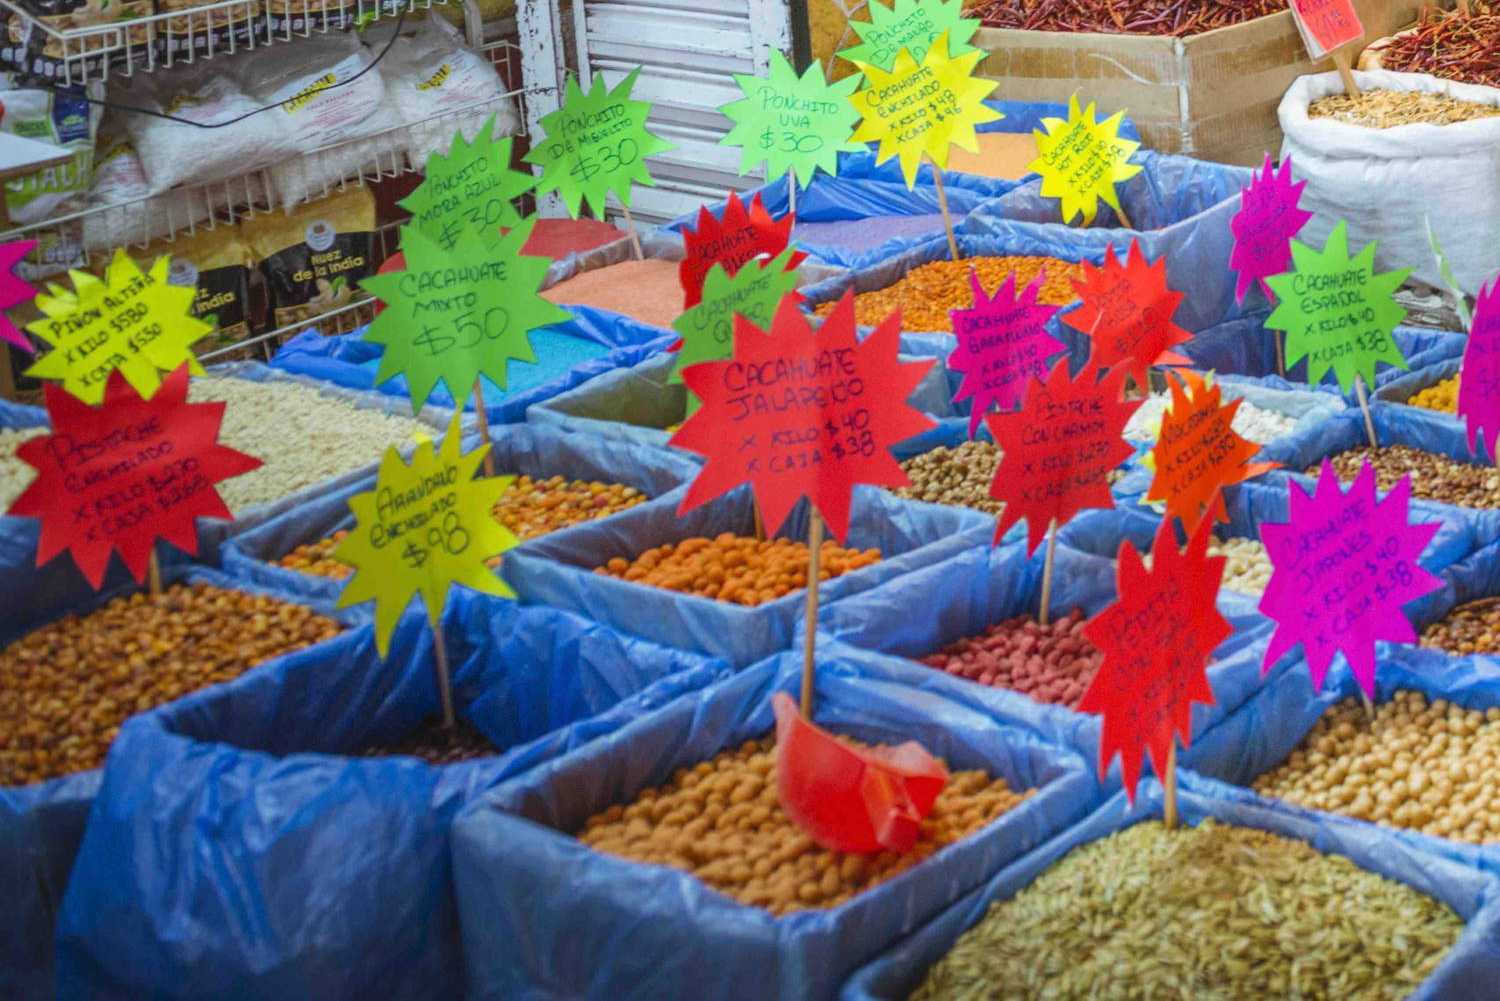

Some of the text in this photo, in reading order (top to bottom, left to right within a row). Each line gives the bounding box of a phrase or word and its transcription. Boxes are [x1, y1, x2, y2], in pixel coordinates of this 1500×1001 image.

[865, 7, 926, 47] PONCHITO
[757, 85, 840, 117] PONCHITO
[866, 65, 935, 108] CACAHUATE
[558, 102, 626, 139] PONCHITO
[779, 111, 811, 129] UVA
[550, 140, 574, 161] DE
[568, 137, 640, 184] $30
[759, 130, 824, 155] $30
[428, 156, 489, 194] PONCHITO
[418, 174, 502, 230] MORA AZUL
[293, 255, 364, 283] de la India
[311, 251, 341, 267] Nuez
[399, 261, 507, 297] CACAHUATE
[1292, 267, 1368, 295] CACAHUATE
[50, 272, 156, 339] PIÑON ALTEÑA
[411, 291, 478, 319] MIXTO
[412, 305, 510, 357] $50
[723, 346, 856, 393] CACAHUATE
[771, 426, 821, 448] KILO
[768, 449, 822, 472] CAJA
[401, 511, 470, 569] $98
